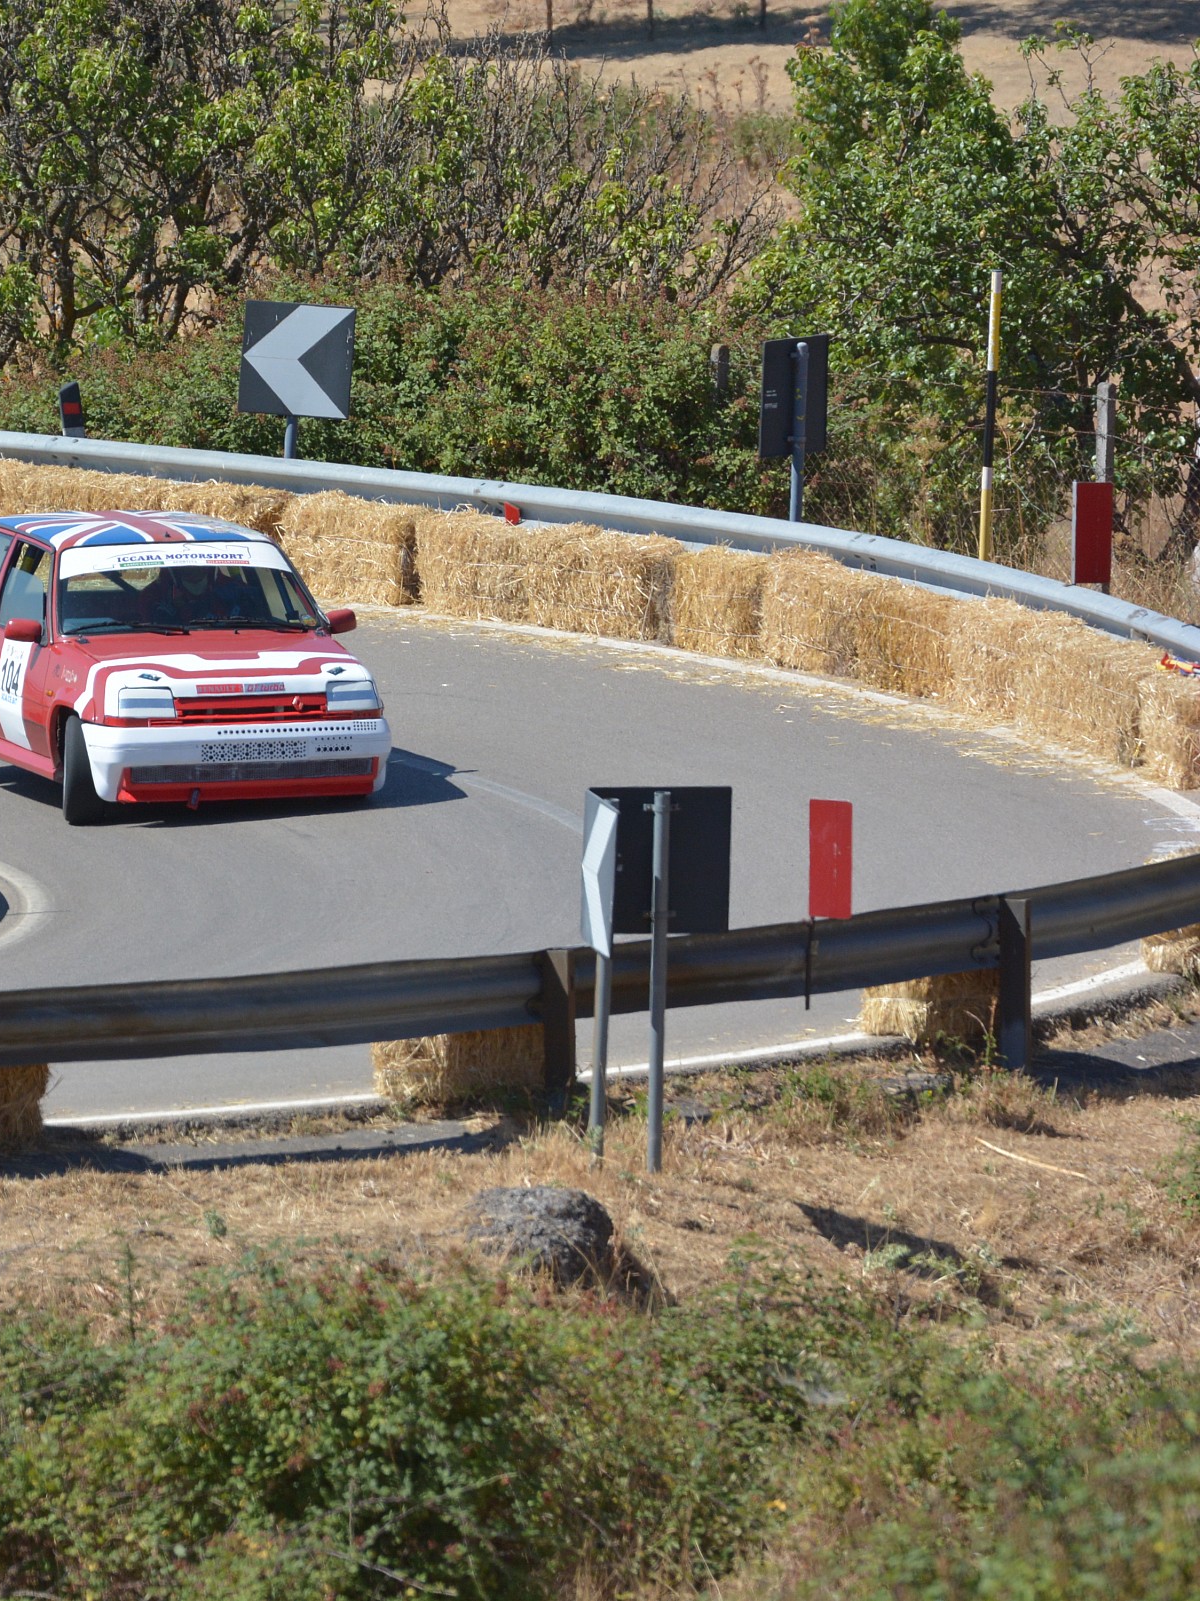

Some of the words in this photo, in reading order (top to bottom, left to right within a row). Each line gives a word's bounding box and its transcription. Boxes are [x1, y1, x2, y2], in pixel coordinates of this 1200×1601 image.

[117, 555, 162, 563] ICCARA
[1, 658, 22, 697] 104
[197, 685, 236, 694] RENAULT
